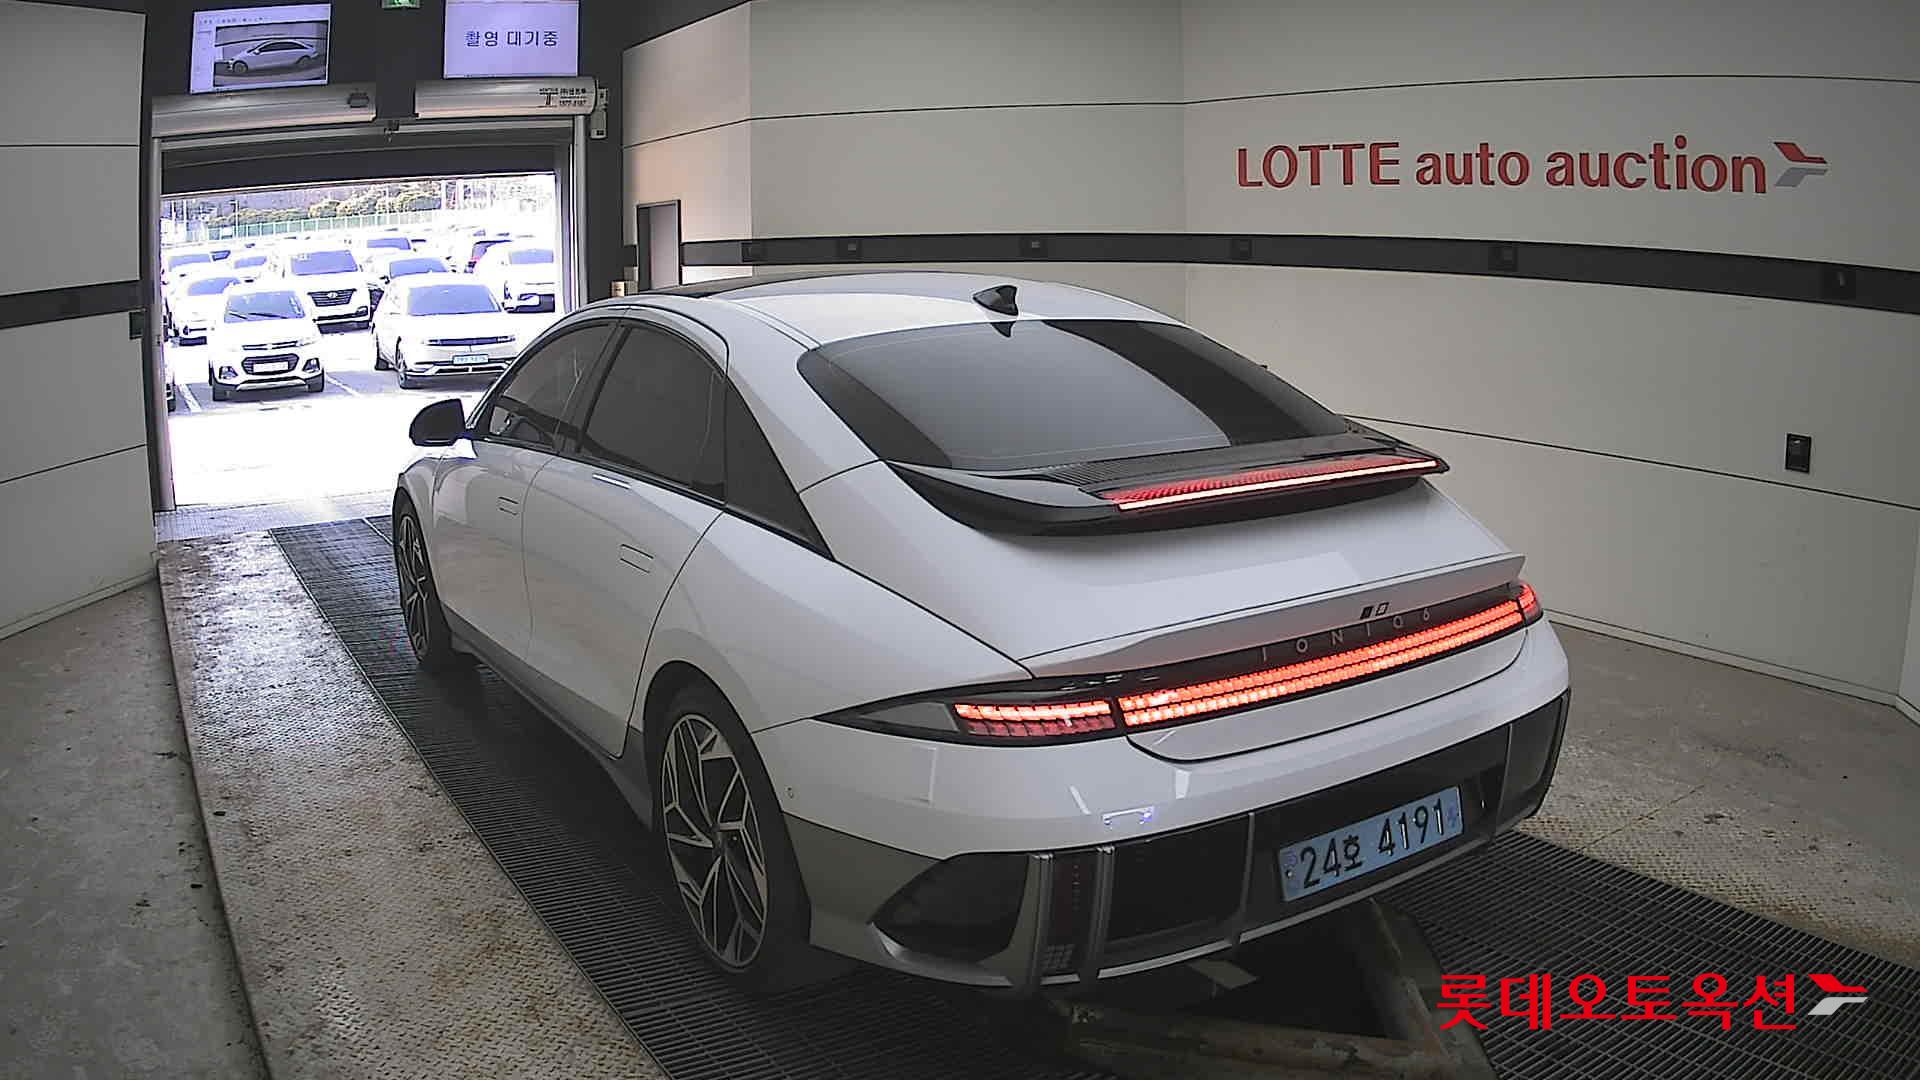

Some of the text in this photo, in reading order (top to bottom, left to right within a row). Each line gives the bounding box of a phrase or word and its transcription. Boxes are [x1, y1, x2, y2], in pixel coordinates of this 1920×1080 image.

[507, 31, 558, 47] 대기중
[1238, 135, 1767, 194] LOTTE auto auction
[1300, 798, 1444, 889] 24호 4191
